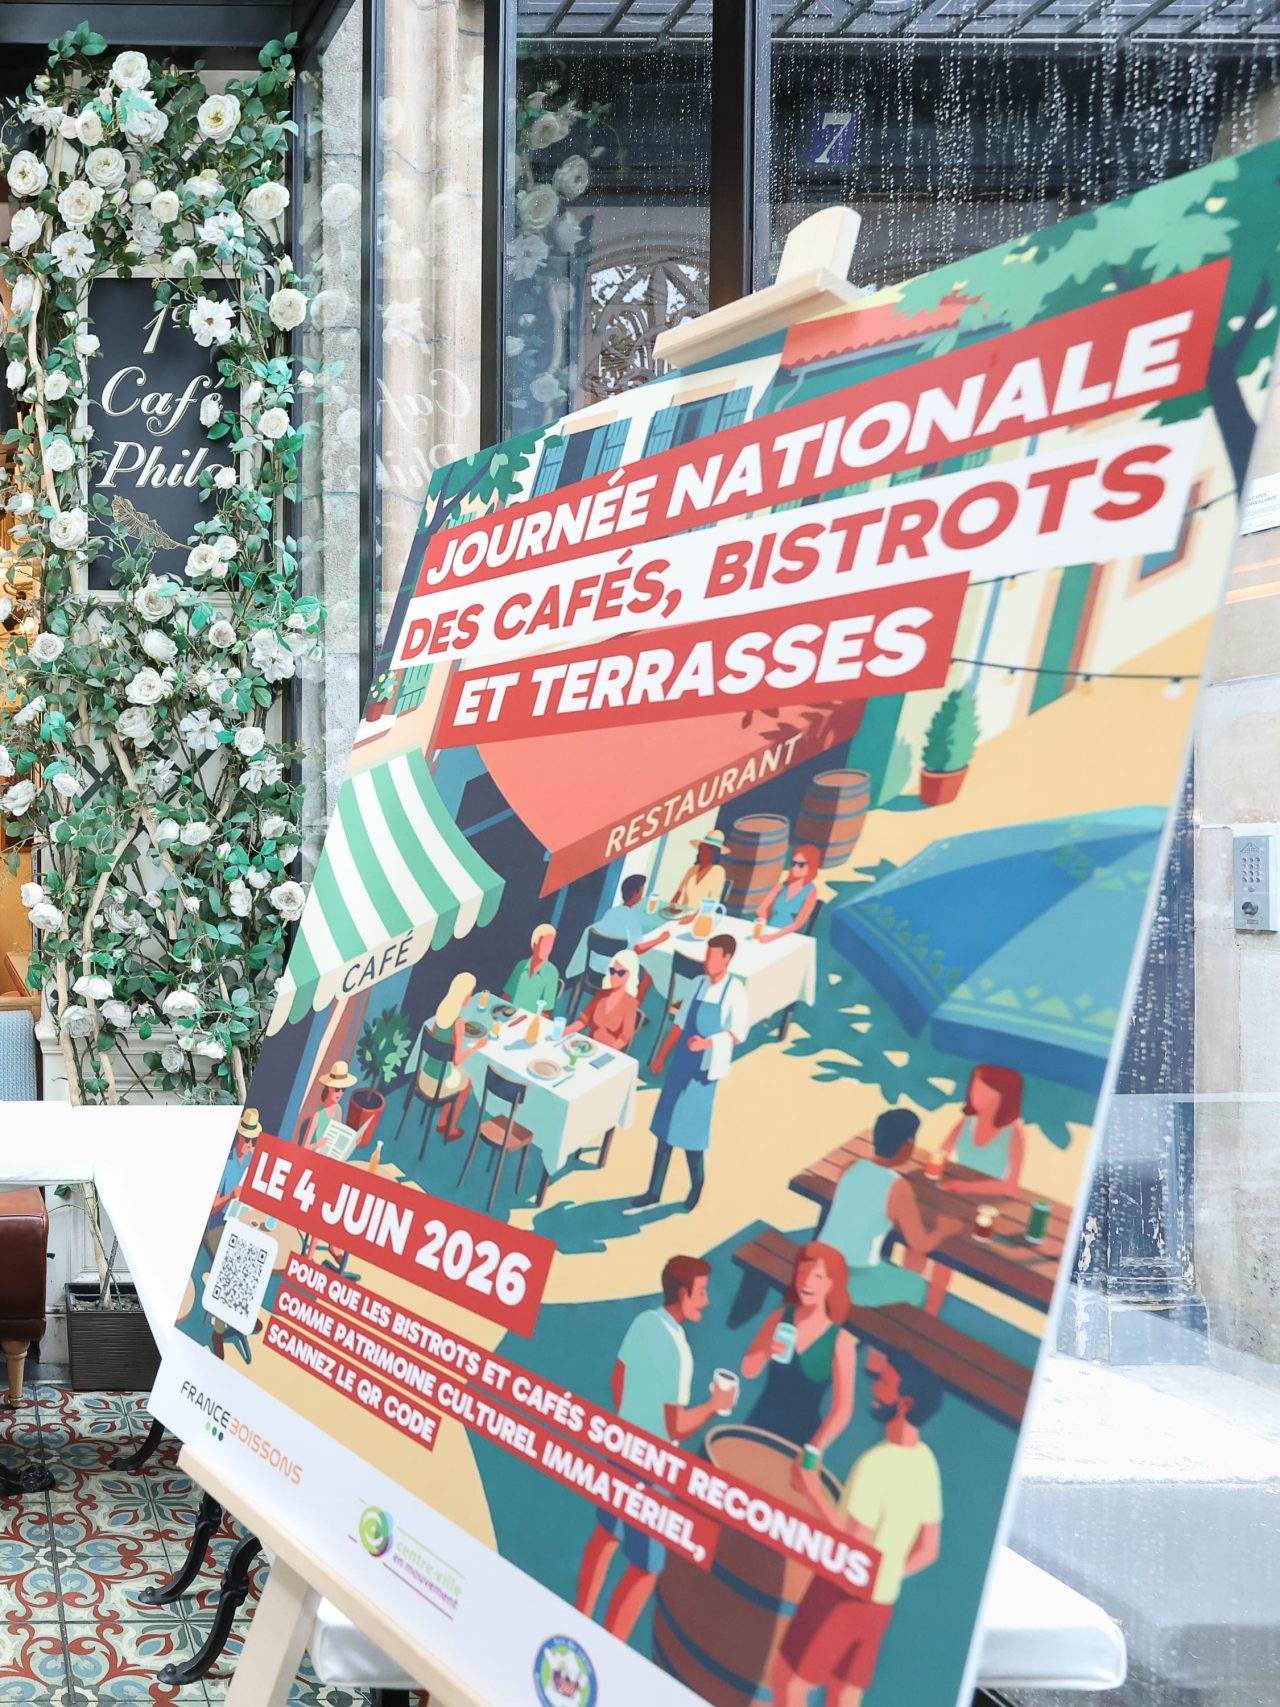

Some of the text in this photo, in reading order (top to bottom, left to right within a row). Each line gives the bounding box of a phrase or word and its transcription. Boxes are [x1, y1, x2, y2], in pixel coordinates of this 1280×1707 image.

[814, 112, 852, 164] 7
[143, 301, 196, 355] 1e
[101, 366, 225, 436] Café
[426, 310, 1195, 583] JOURNÉE NATIONALE
[400, 443, 1170, 662] DES CAFÉS, BISTROTS
[451, 606, 935, 727] ET TERRASSES
[604, 733, 804, 858] RESTAURANT
[341, 929, 416, 995] CAFÉ
[250, 1151, 533, 1306] LE 4 JUIN 2026
[267, 1323, 436, 1443] SCANNEZ LE QR CODE
[278, 1291, 708, 1562] COMME PATRIMOINE CULTUREL IMMATÉRIEL,
[287, 1258, 874, 1587] POUR QUE LES BISTROTS ET CAFÉS SOIENT RECONNUS
